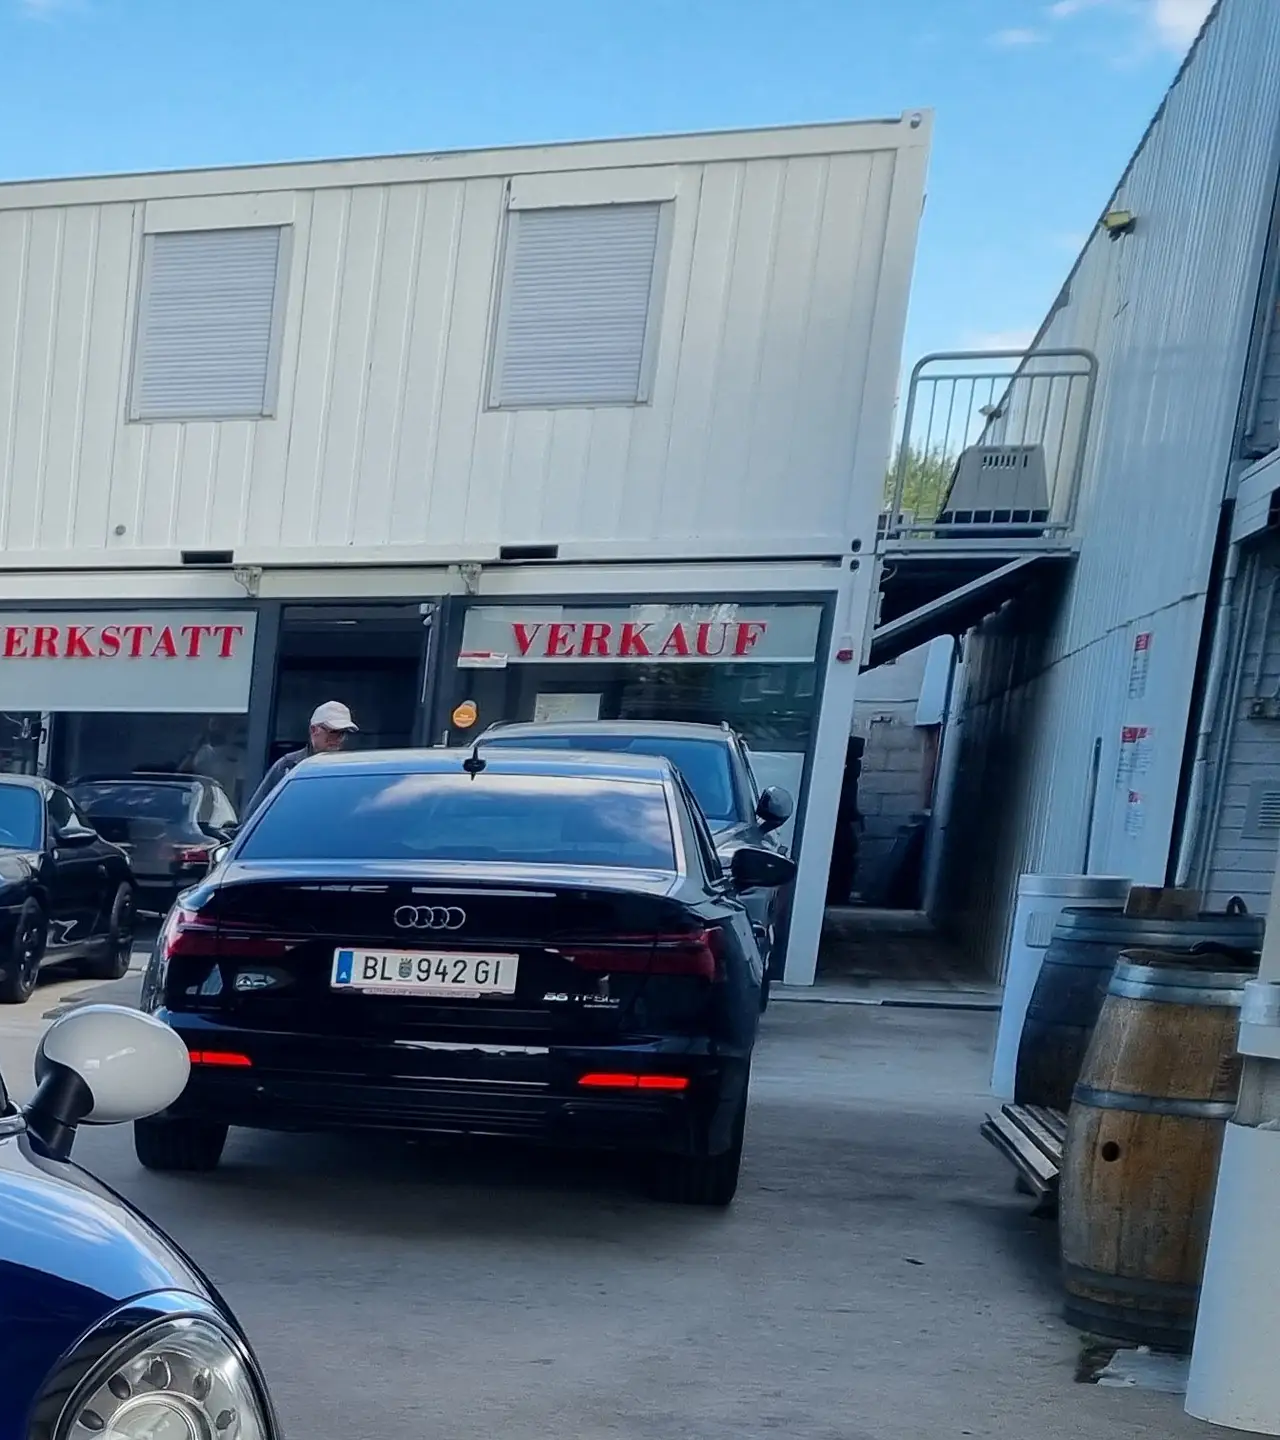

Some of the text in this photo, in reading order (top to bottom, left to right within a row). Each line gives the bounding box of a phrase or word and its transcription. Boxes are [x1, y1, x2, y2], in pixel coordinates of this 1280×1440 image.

[511, 622, 768, 657] VERKAUF
[362, 956, 501, 985] BL 942 GI
